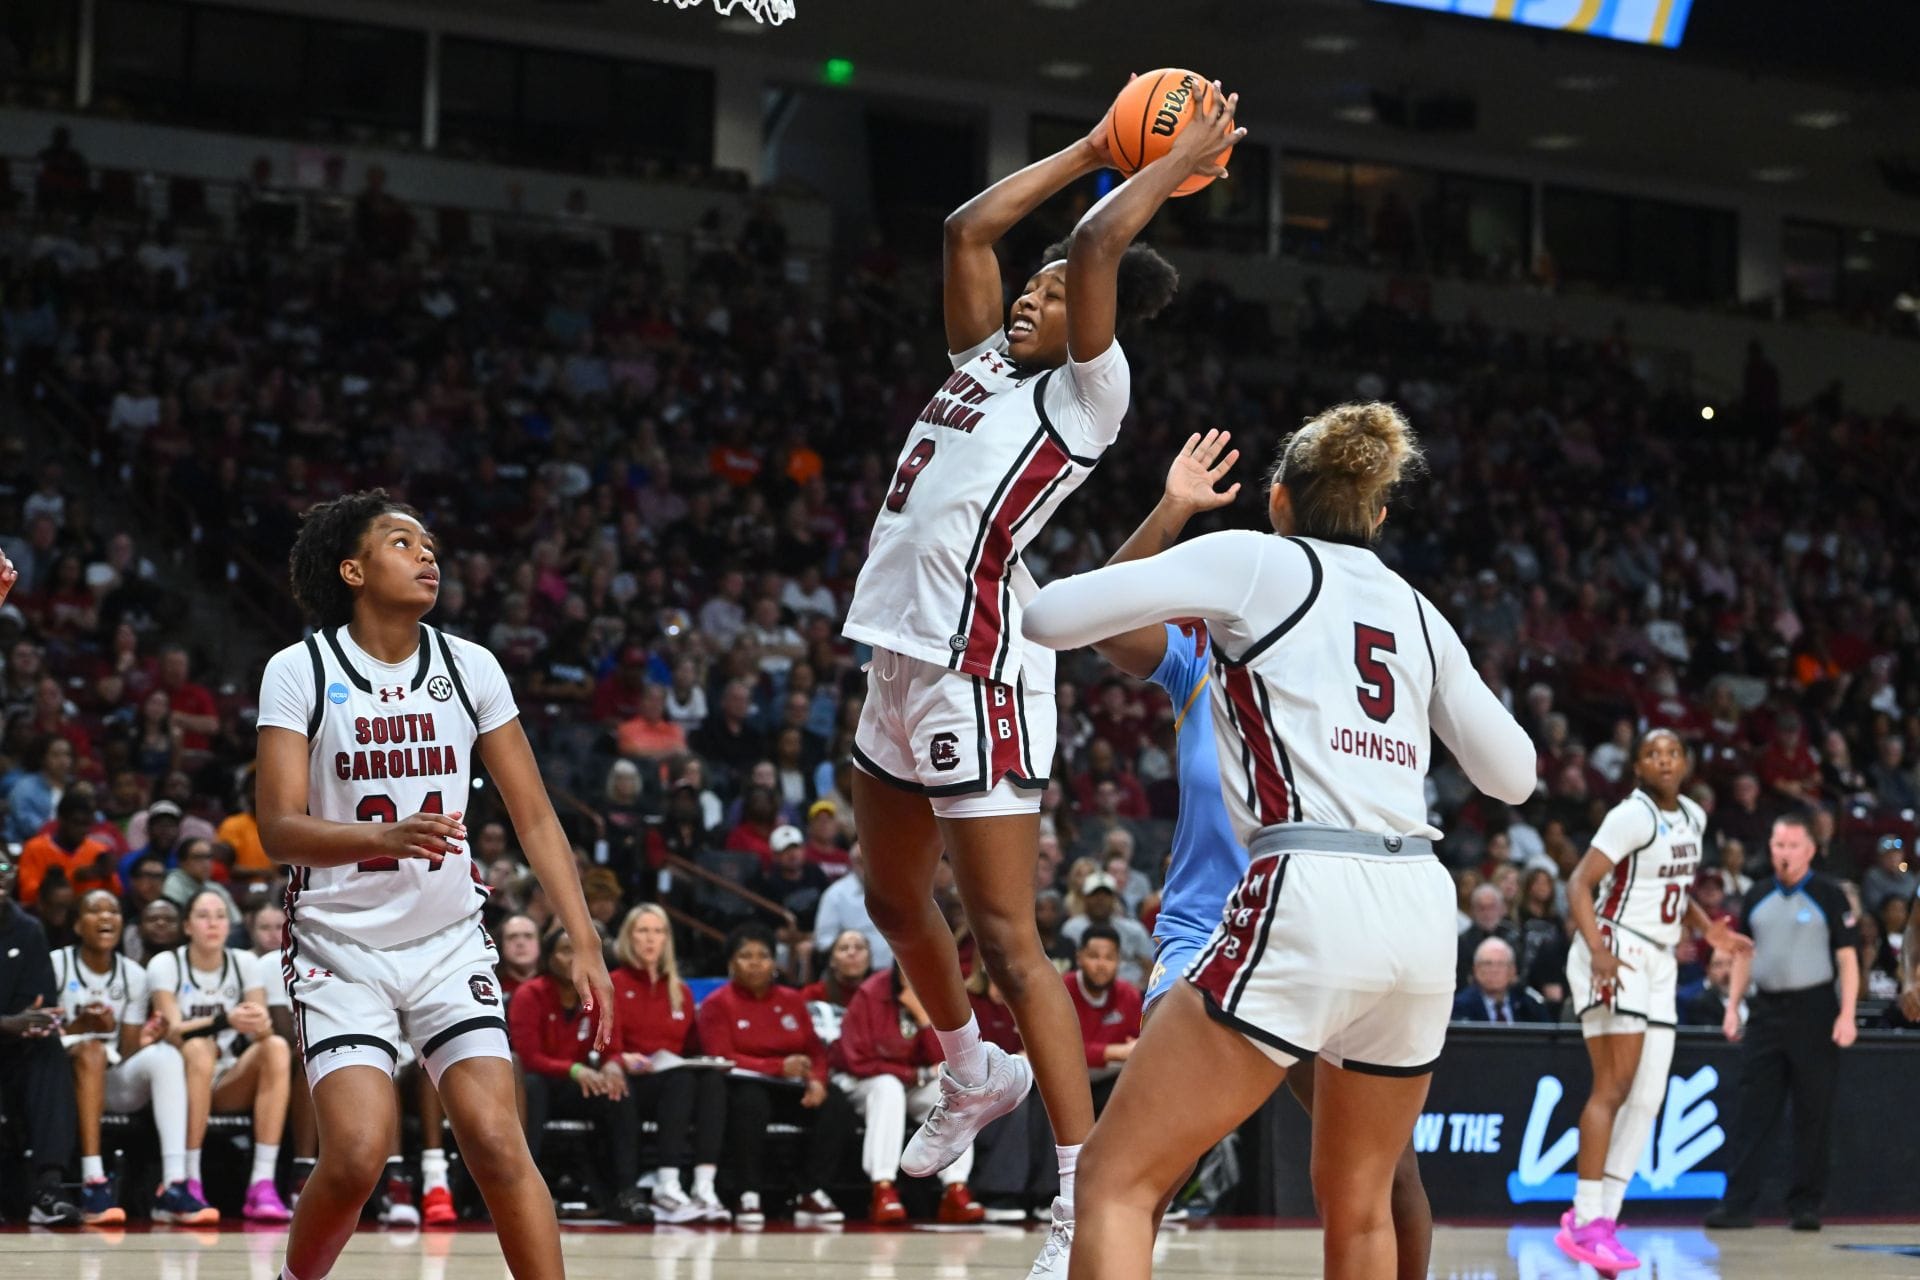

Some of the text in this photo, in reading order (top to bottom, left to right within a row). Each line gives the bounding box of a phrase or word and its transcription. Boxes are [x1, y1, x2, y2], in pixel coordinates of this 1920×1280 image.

[886, 438, 935, 513] 8
[1354, 622, 1397, 724] 5
[355, 713, 435, 744] SOUTH
[1330, 726, 1416, 770] JOHNSON
[335, 745, 457, 780] CAROLINA
[1413, 1113, 1444, 1152] W
[1449, 1113, 1503, 1152] THE
